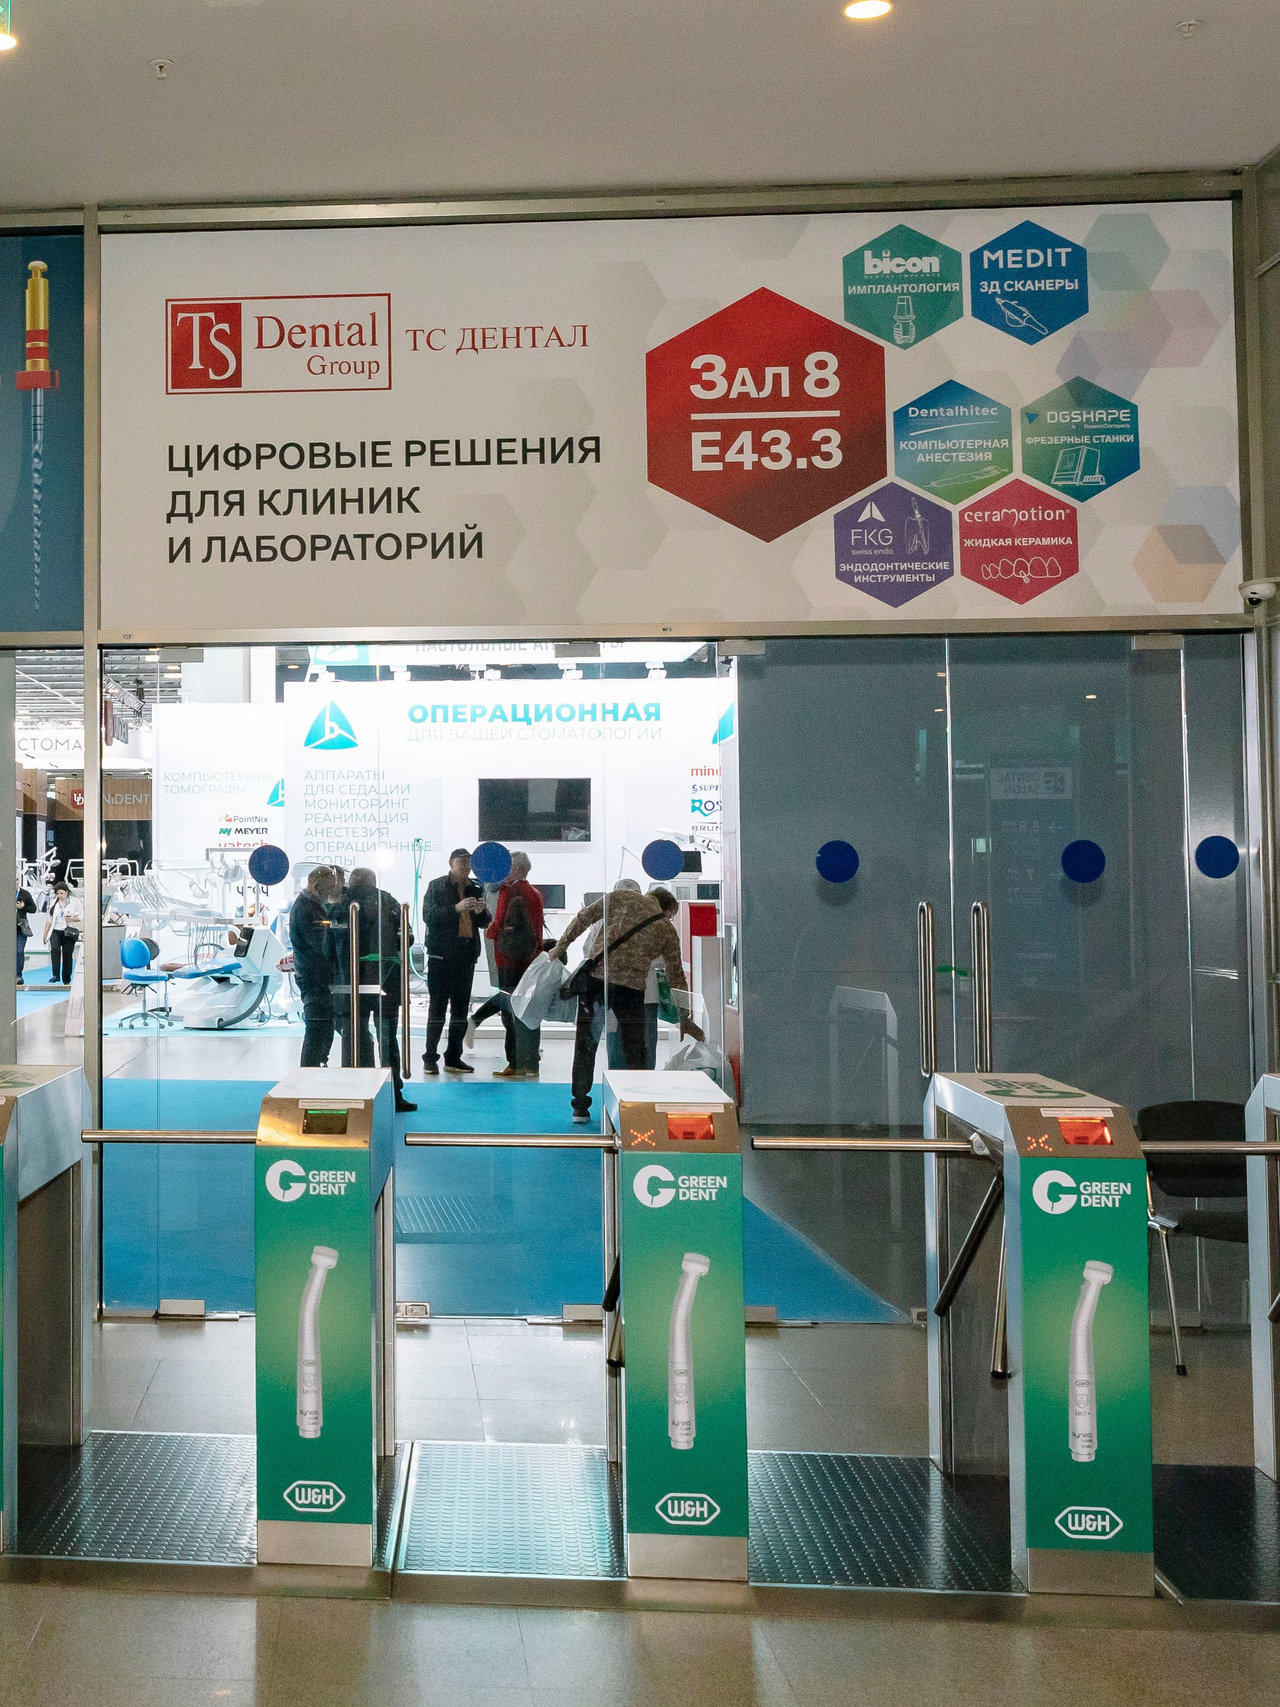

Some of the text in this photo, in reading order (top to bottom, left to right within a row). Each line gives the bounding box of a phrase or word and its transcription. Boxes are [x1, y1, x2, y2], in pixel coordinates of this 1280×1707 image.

[863, 249, 940, 274] bicon
[982, 247, 1072, 269] MEDIT
[847, 282, 960, 295] ИМПЛАНТОЛОГИЯ
[1003, 279, 1079, 292] СКАНЕРЫ
[254, 311, 379, 350] Dental
[176, 312, 237, 381] TS
[405, 324, 590, 356] ТС ДЕНТАЛ
[306, 355, 381, 379] Group
[803, 351, 841, 398] 8
[908, 404, 998, 418] Dentalhitec
[1047, 409, 1131, 423] DGSHAPE
[899, 438, 1009, 451] КОМПЬЮТЕРНАЯ
[1025, 434, 1134, 445] ФРЕЗЕРНЫЕ СТАНКИ
[167, 436, 602, 478] ЦИФРОВЫЕ РЕШЕНИЯ
[916, 452, 993, 463] АНЕСТЕЗИЯ
[166, 486, 422, 524] ДЛЯ КЛИНИК
[167, 523, 485, 564] И ЛАБОРАТОРИЙ
[851, 528, 893, 546] FKG
[963, 536, 1073, 549] ЖИДКАЯ КЕРАМИКА
[873, 548, 894, 556] endo
[839, 561, 950, 573] ЭНДОДОНТИЧЕСКИЕ
[853, 573, 936, 584] ИНСТРУМЕНТЫ
[407, 702, 662, 726] ОПЕРАЦИОННАЯ
[406, 728, 444, 743] ДЛЯ
[517, 726, 663, 741] СТОМАТОЛОГИИ
[163, 771, 276, 782] КОМПЬЮТЕРНЫЕ
[304, 770, 385, 781] АППАРАТЫ
[163, 784, 247, 795] ТОМОГРАФЫ
[303, 784, 410, 797] ДЛЯ СЕДАЦИИ
[304, 798, 409, 810] МОНИТОРИНГ
[233, 815, 269, 823] PointNix
[304, 812, 409, 825] РЕАНИМАЦИЯ
[234, 827, 269, 835] MEYER
[304, 826, 389, 838] АНЕСТЕЗИЯ
[308, 1170, 356, 1183] GREEN
[677, 1175, 727, 1189] GREEN
[309, 1183, 347, 1195] DENT
[678, 1188, 718, 1201] DENT
[1079, 1181, 1131, 1195] GREEN
[1080, 1195, 1122, 1208] DENT
[294, 1487, 335, 1507] W&H
[667, 1500, 709, 1519] W&H
[1067, 1513, 1111, 1533] W&H
